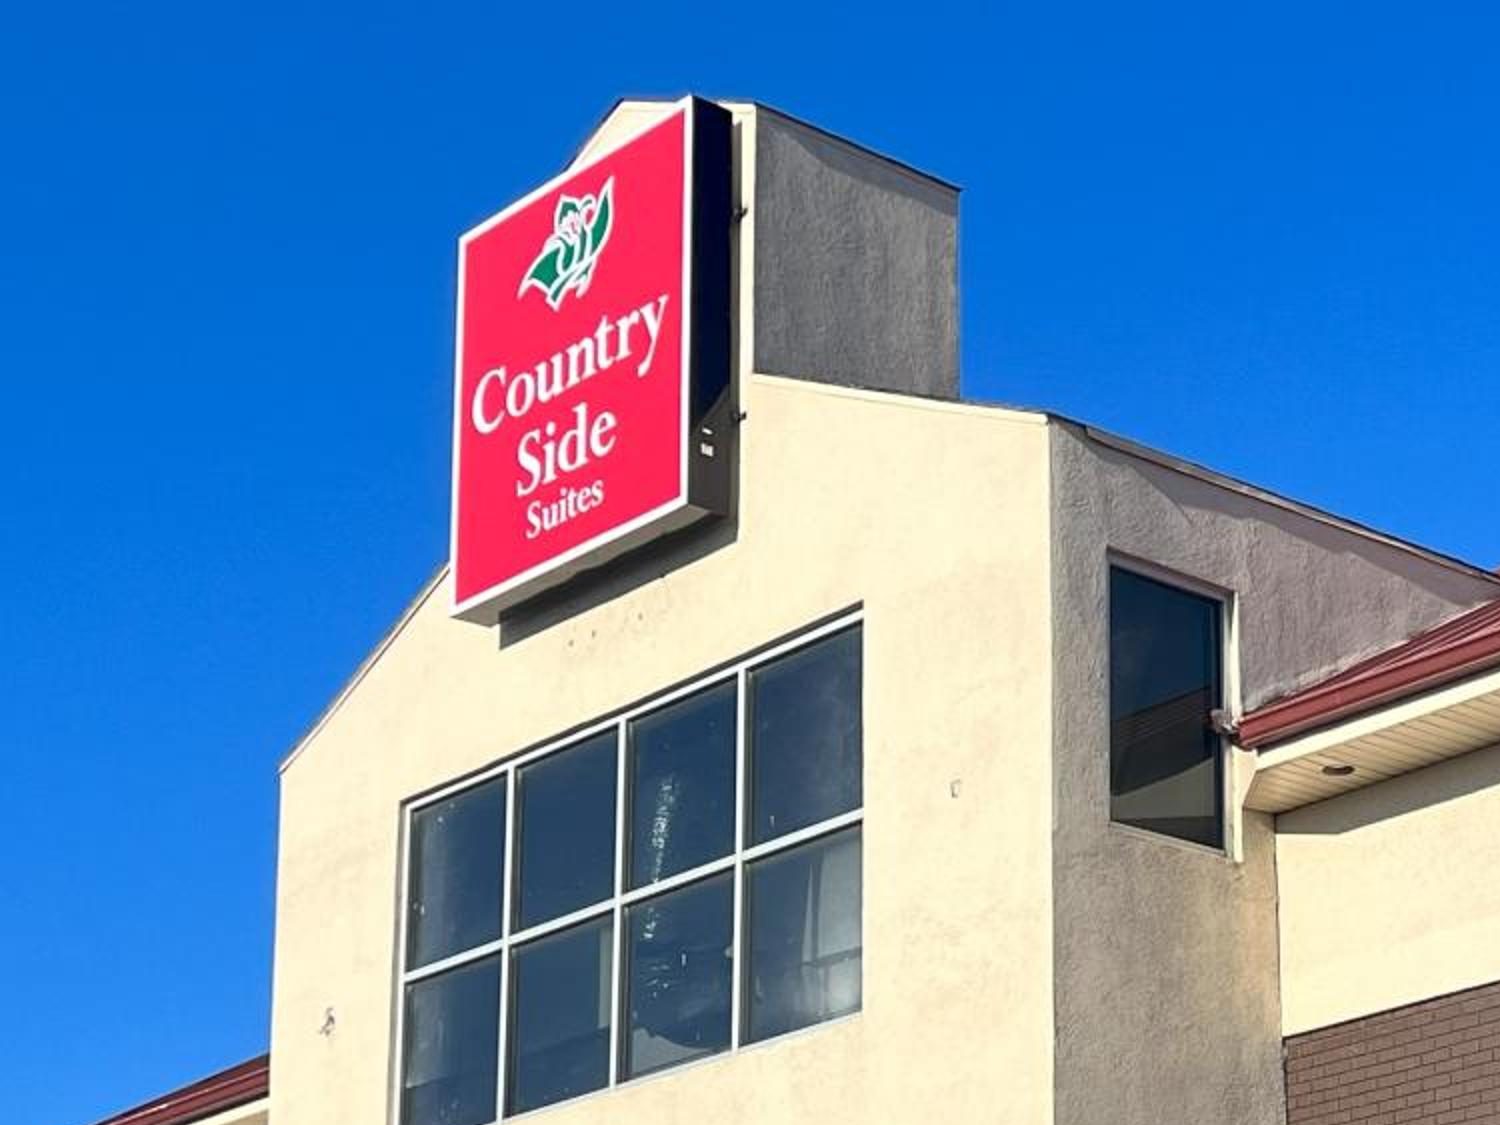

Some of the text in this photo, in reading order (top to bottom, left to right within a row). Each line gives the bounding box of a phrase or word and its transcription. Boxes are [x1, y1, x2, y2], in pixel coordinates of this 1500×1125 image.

[471, 294, 668, 436] Country
[516, 401, 617, 497] Side
[525, 479, 604, 539] Suites
